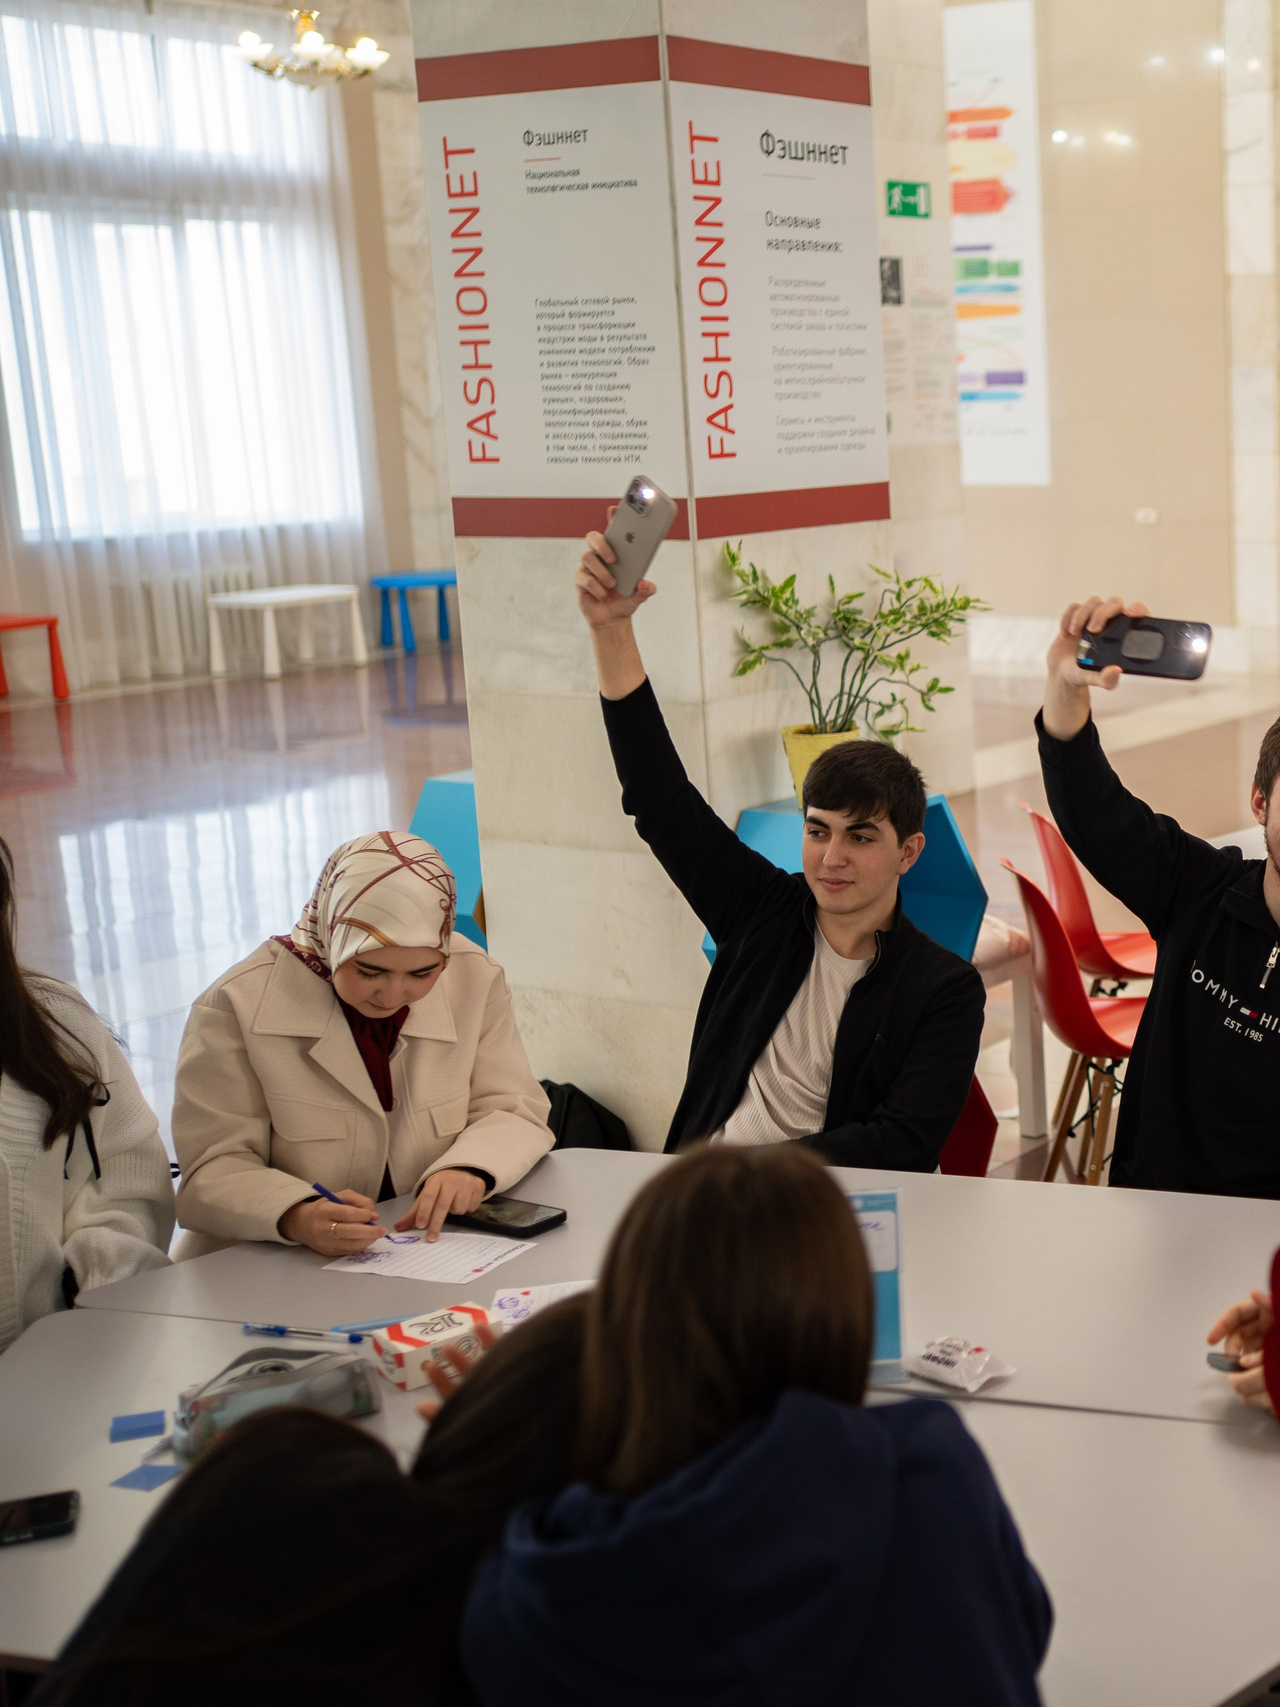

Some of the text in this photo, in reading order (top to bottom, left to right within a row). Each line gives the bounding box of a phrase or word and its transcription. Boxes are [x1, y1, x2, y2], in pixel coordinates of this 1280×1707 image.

[522, 128, 589, 147] Фэшннет
[760, 128, 848, 165] Фэшннет
[765, 210, 821, 229] Основные
[766, 238, 843, 253] направления:
[443, 135, 500, 464] FASHIONNET
[688, 120, 737, 460] FASHIONNET
[1191, 961, 1239, 1009] OMMY
[1223, 1017, 1264, 1043] EST. 1985
